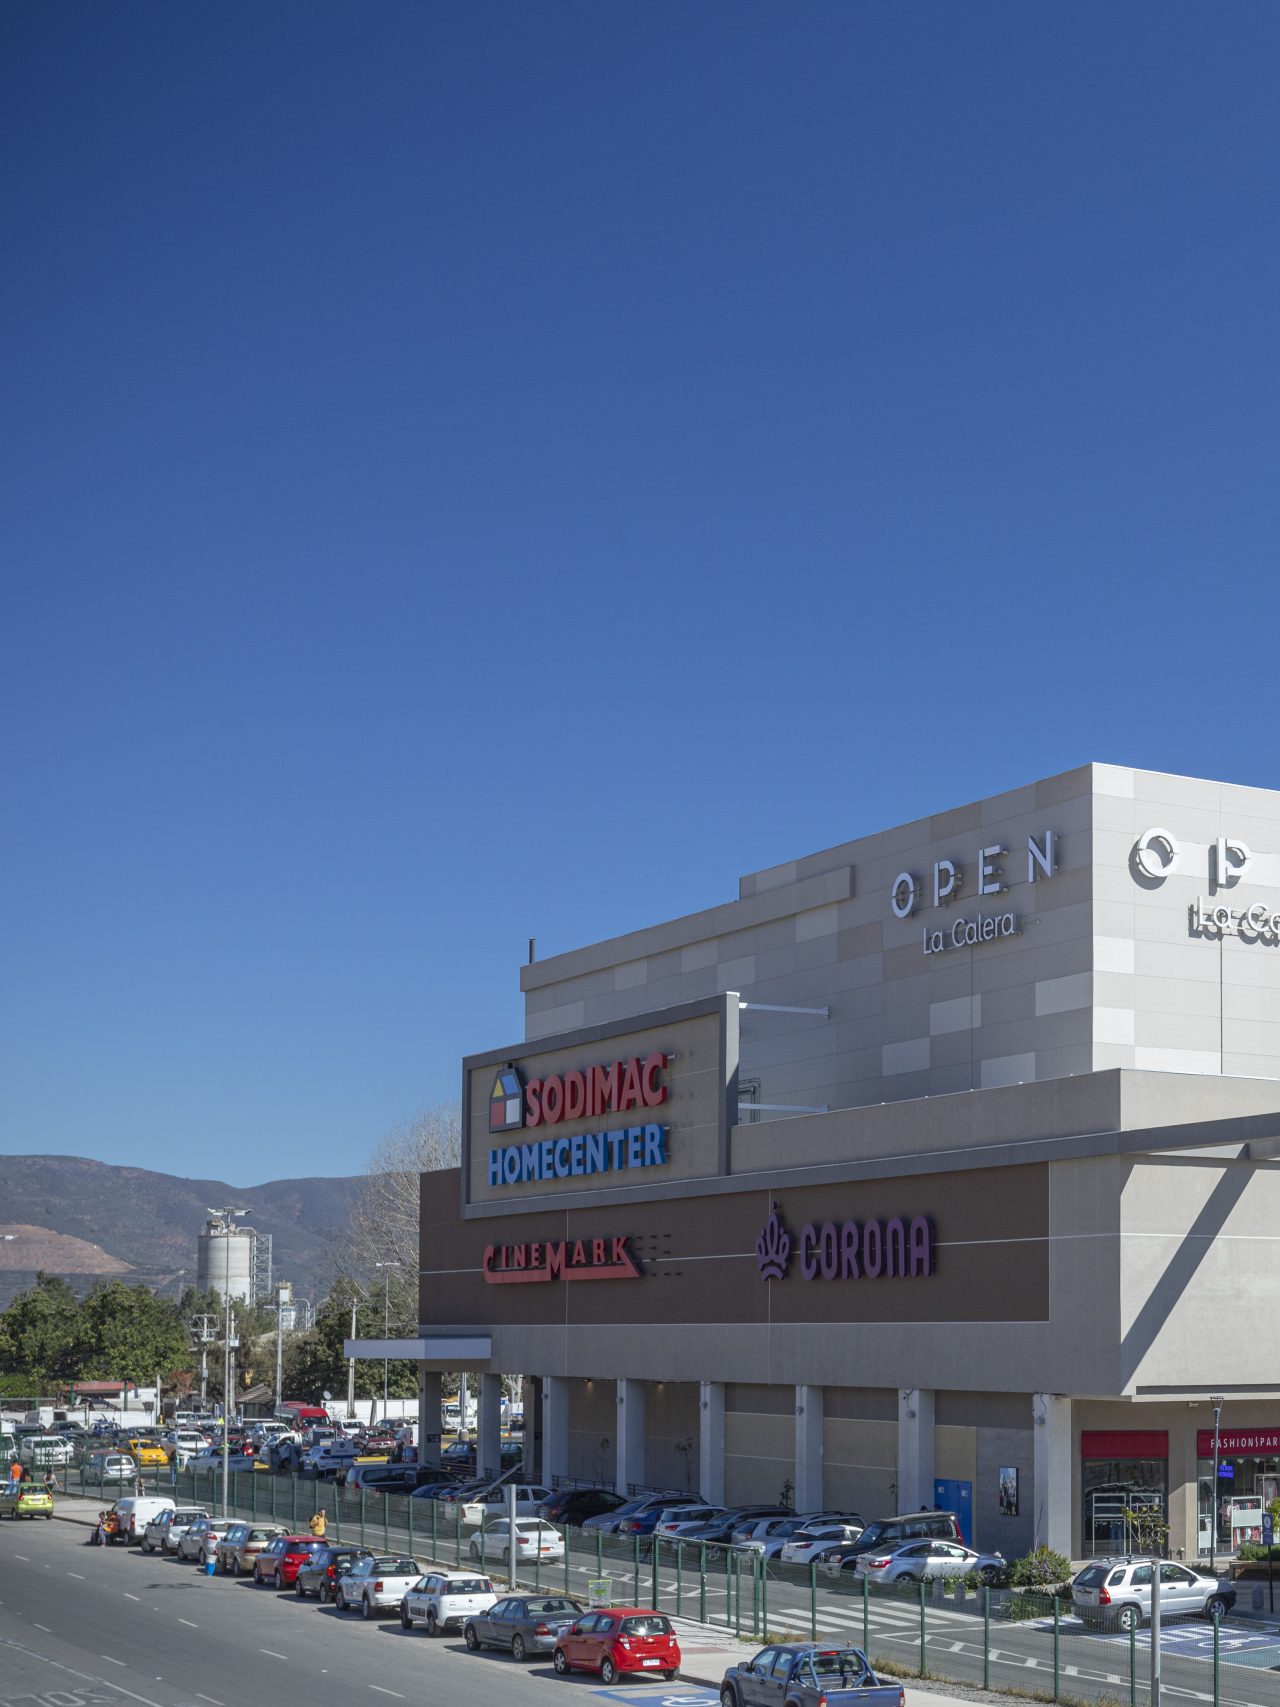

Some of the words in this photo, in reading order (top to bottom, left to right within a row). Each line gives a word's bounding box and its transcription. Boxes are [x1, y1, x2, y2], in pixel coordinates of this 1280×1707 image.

[891, 830, 1055, 919] OPEN
[923, 926, 944, 955] La
[951, 912, 1015, 949] Calera
[1196, 895, 1234, 929] La
[526, 1051, 669, 1128] SODIMAC
[488, 1123, 668, 1187] HOMECENTER
[482, 1236, 642, 1285] CINEMARK
[799, 1215, 936, 1283] CORONA
